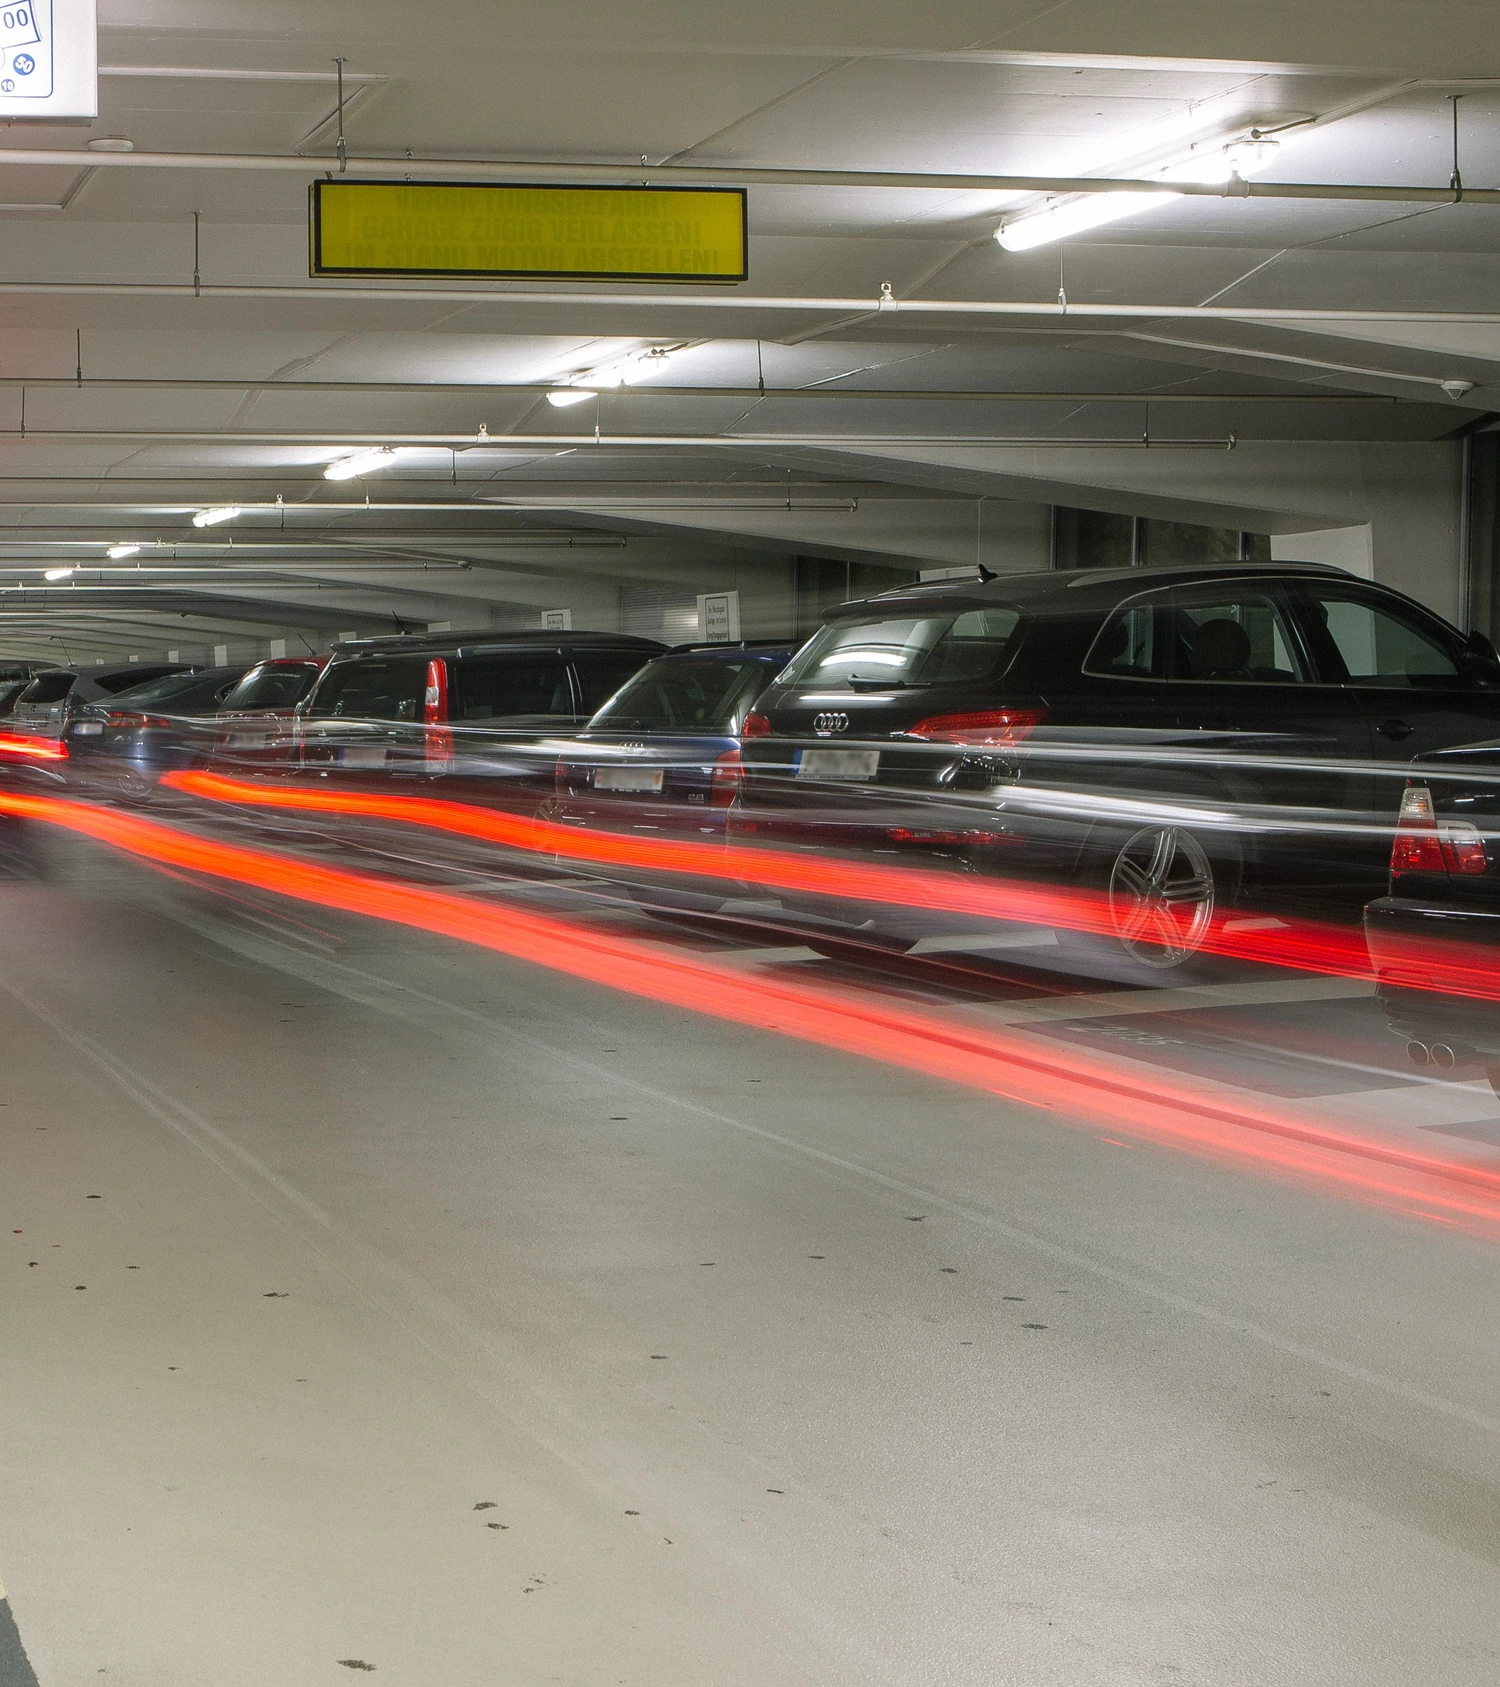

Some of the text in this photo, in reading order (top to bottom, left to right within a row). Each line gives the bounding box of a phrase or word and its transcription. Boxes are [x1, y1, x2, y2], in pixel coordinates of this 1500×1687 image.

[15, 55, 34, 74] 50
[1, 79, 15, 92] 10
[362, 215, 461, 241] GARAGE
[551, 219, 701, 246] VERLASSEN!
[387, 243, 467, 269] STAND
[478, 244, 564, 270] MOTOR
[574, 246, 720, 273] ABSTELLEN!
